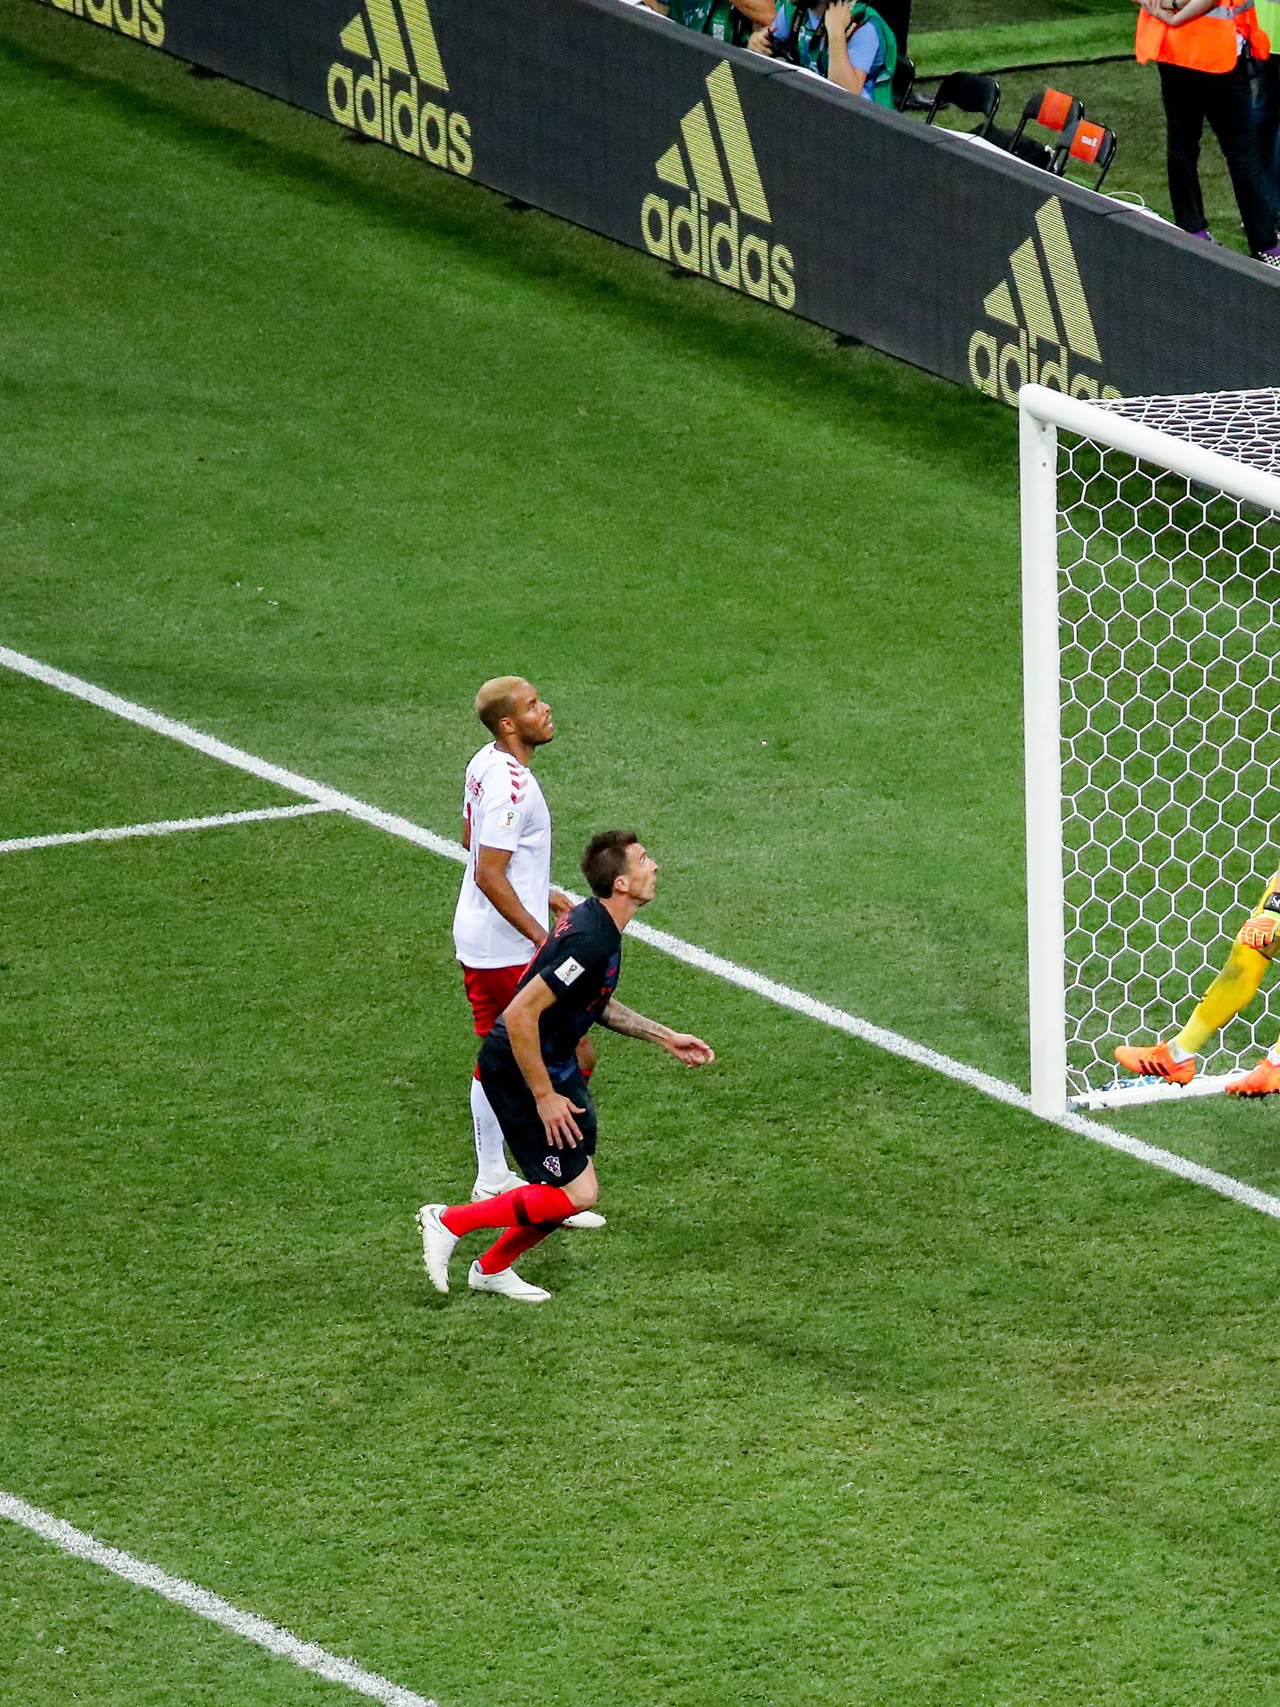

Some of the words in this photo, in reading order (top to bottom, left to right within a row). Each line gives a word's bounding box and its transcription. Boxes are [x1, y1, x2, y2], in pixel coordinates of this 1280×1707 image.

[327, 59, 473, 176] adidas
[641, 190, 796, 310] adidas
[968, 328, 1123, 408] adid
